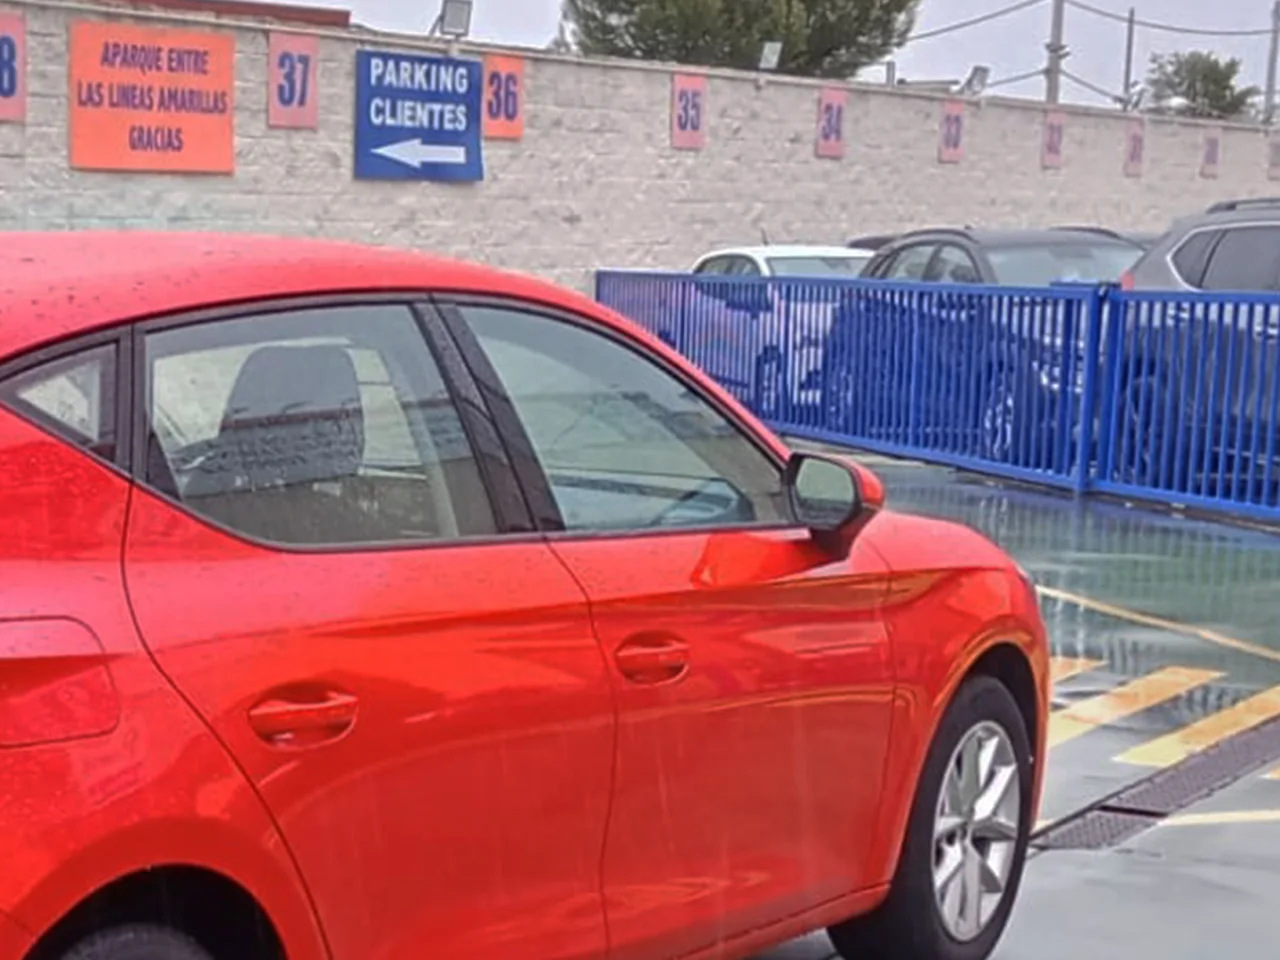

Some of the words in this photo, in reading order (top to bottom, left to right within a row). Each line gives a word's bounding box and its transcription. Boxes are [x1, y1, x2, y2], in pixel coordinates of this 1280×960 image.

[101, 42, 162, 75] APARQUE
[167, 48, 209, 75] ENTRE
[370, 57, 468, 94] PARKING
[77, 79, 104, 107] LAS
[108, 83, 154, 111] LINEAS
[157, 87, 228, 114] AMARILLAS
[277, 51, 310, 107] 37
[487, 71, 518, 122] 36
[370, 97, 468, 131] CLIENTES
[677, 89, 701, 131] 35
[822, 103, 843, 142] 34
[129, 125, 184, 152] GRACIAS
